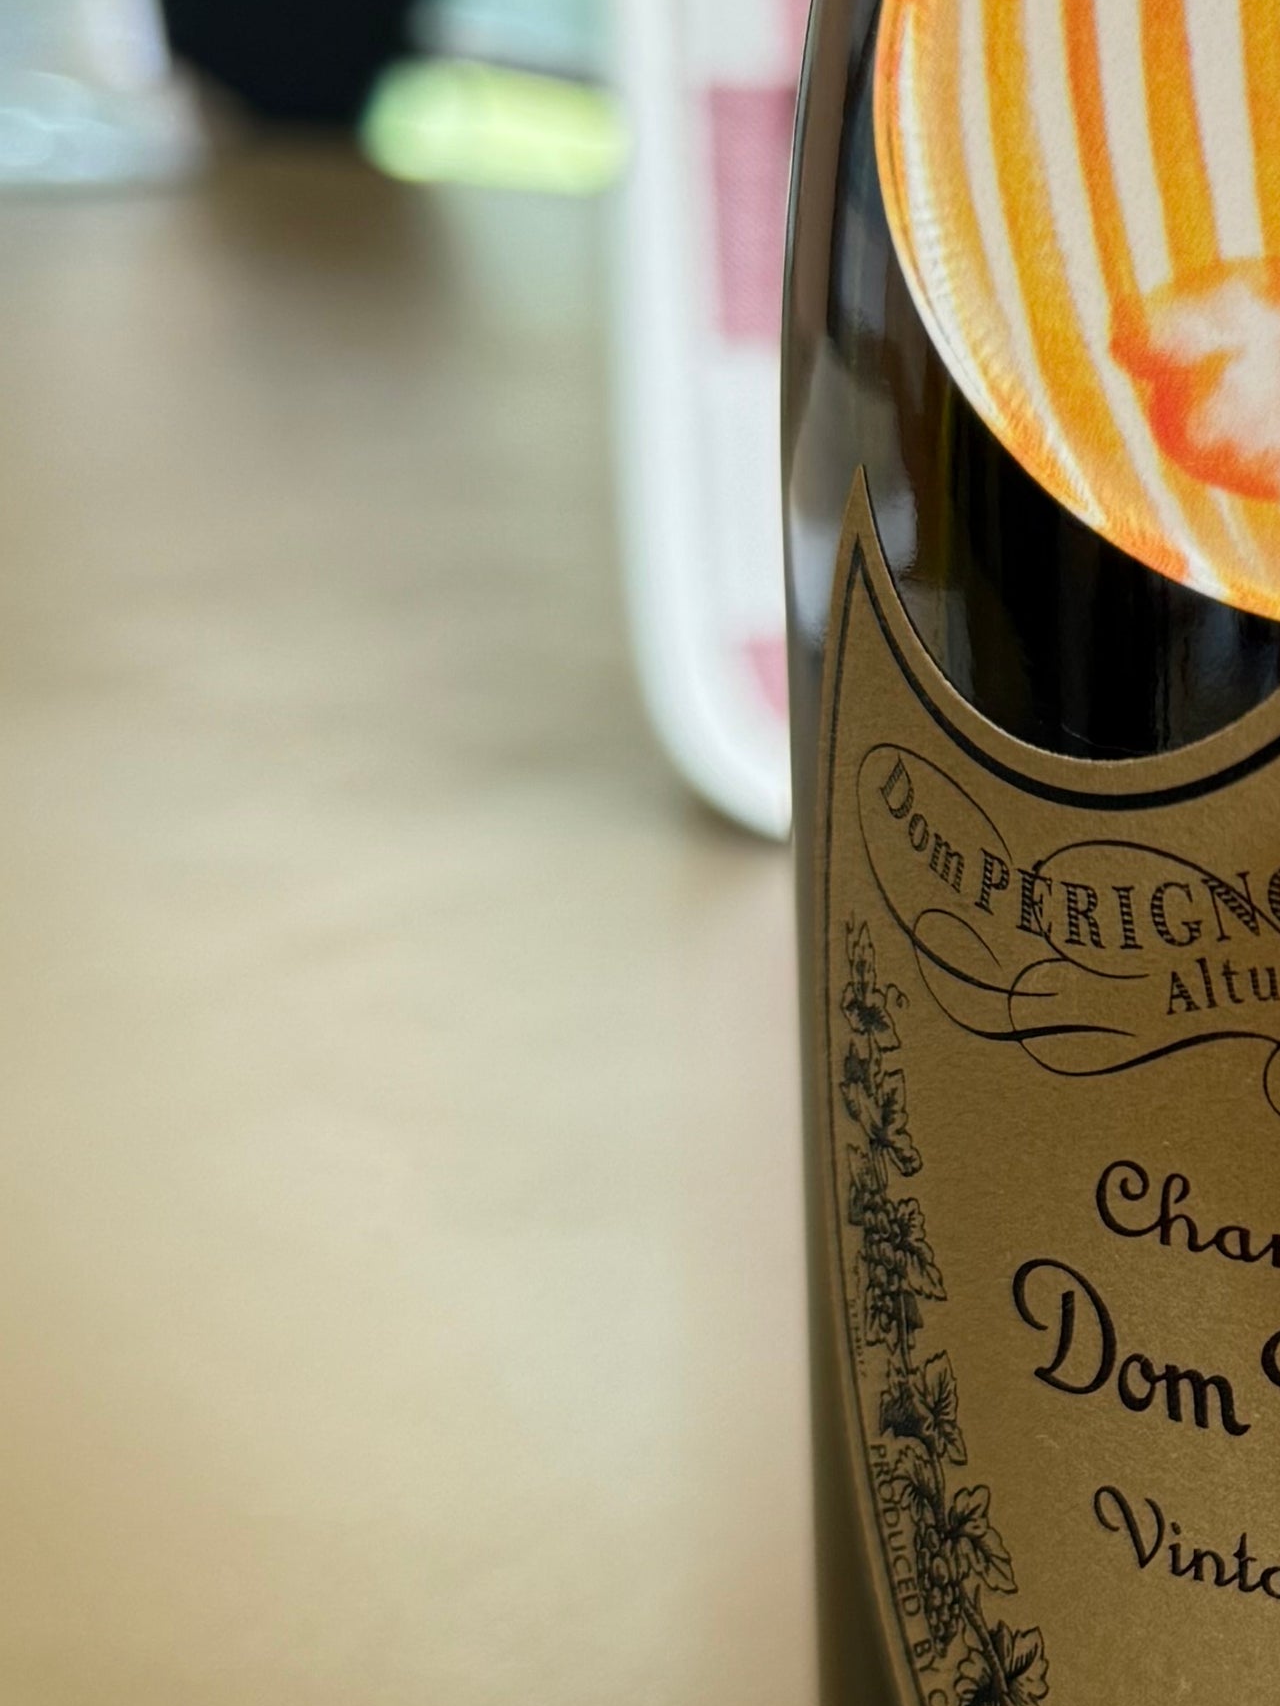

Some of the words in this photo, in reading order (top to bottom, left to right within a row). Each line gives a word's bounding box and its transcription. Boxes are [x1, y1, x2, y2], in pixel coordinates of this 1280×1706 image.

[880, 755, 965, 894] Dom
[1012, 1258, 1250, 1437] Dom
[869, 1443, 922, 1618] PRODUCED
[913, 1638, 939, 1673] BY
